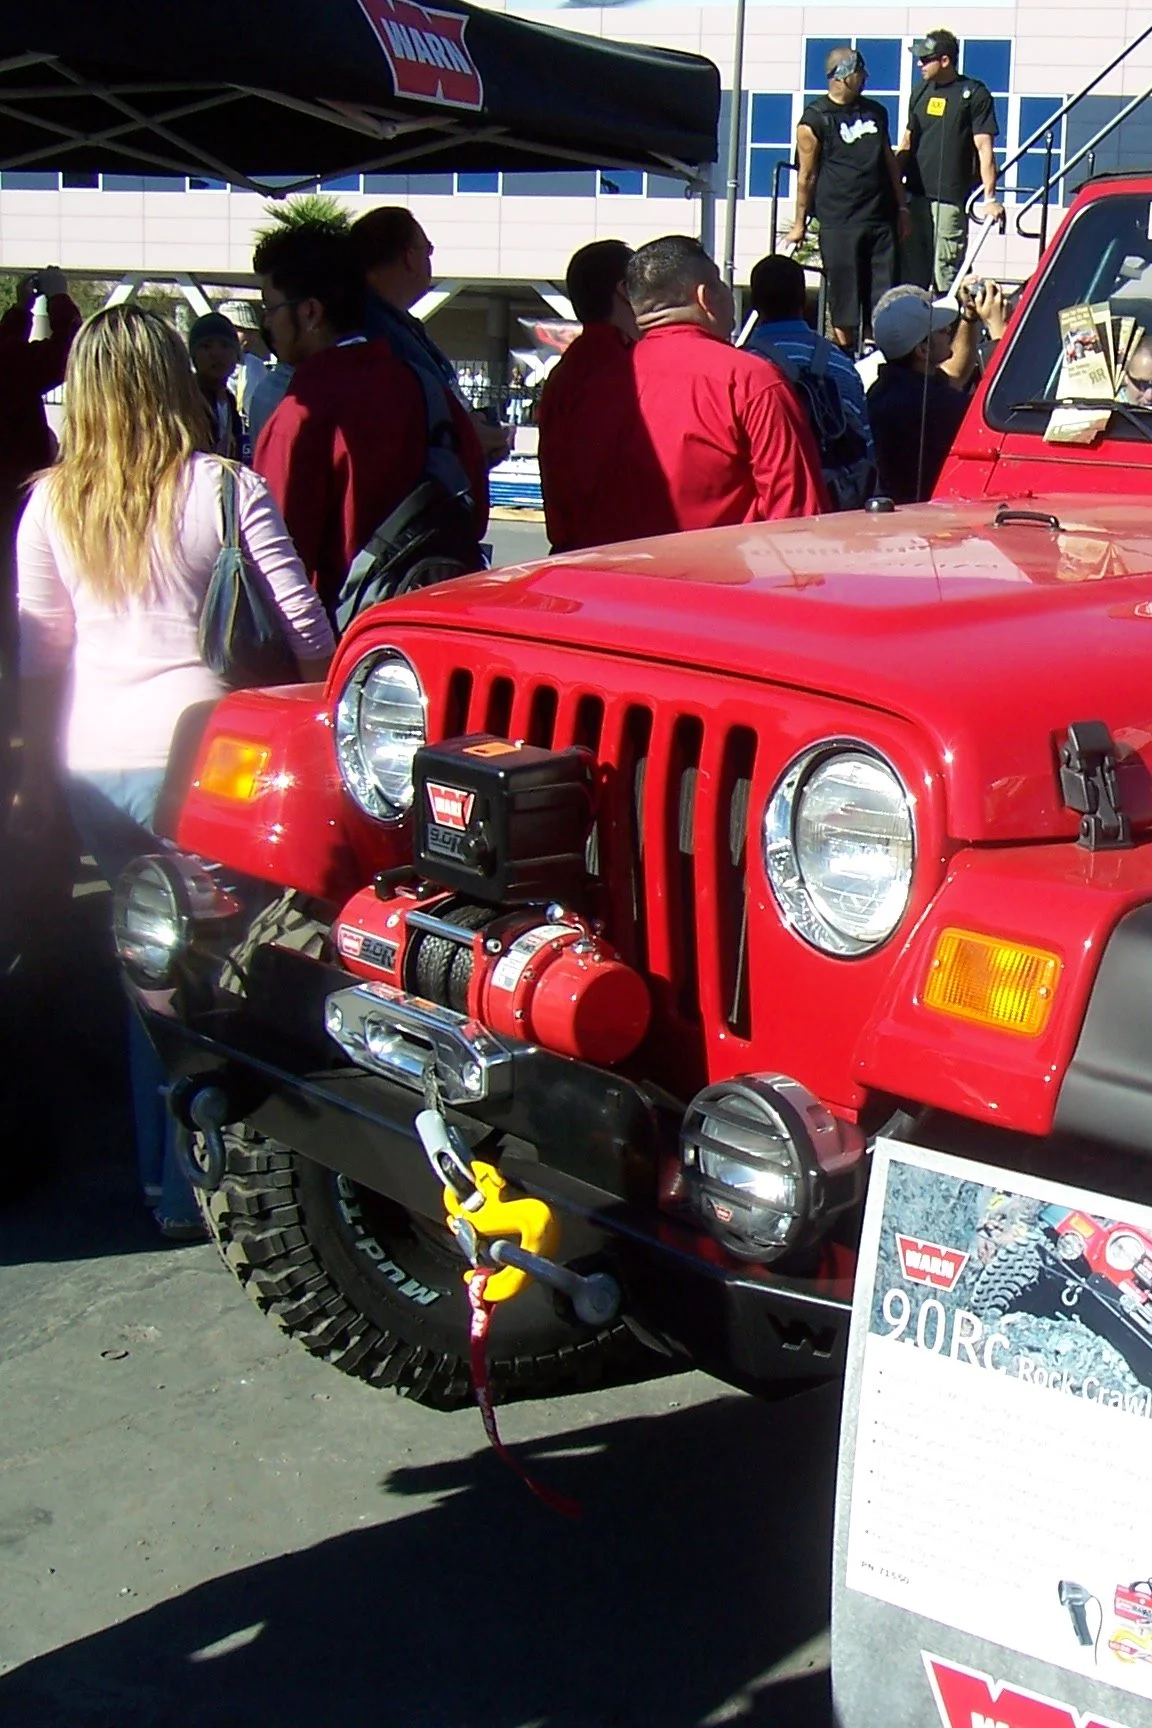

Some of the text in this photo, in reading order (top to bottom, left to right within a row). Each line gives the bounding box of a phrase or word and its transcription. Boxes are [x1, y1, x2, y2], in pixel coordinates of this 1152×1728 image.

[381, 17, 472, 75] WARN
[904, 1249, 956, 1280] WARN
[1018, 1356, 1078, 1395] Rock
